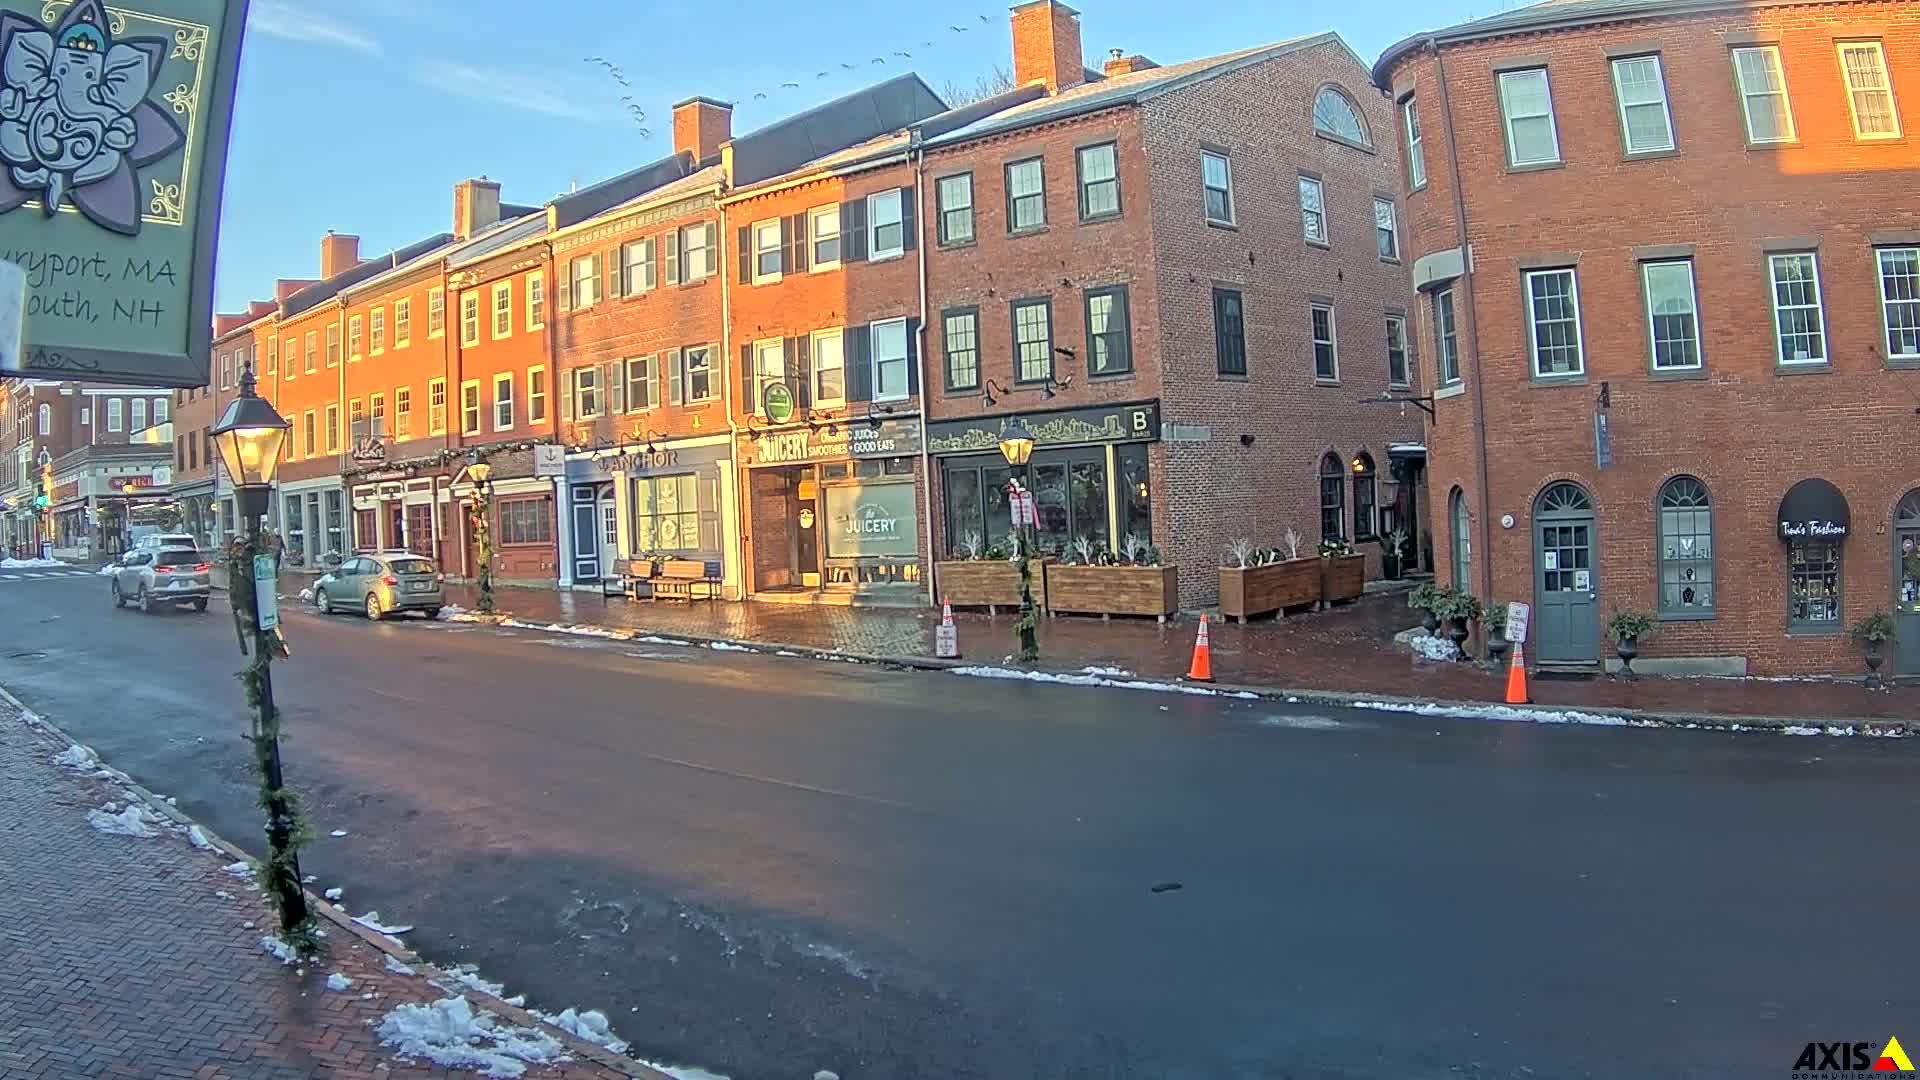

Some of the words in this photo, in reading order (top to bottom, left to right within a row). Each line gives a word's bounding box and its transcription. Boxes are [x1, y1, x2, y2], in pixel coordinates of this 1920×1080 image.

[122, 257, 176, 287] MA
[113, 298, 165, 328] NH
[1133, 411, 1147, 431] B
[758, 432, 809, 463] JUICERY
[808, 443, 848, 457] SMOOTHIES
[853, 441, 877, 453] GOOD
[877, 439, 895, 452] EATS
[611, 449, 679, 472] ANCHOR
[845, 518, 897, 534] JUICERY
